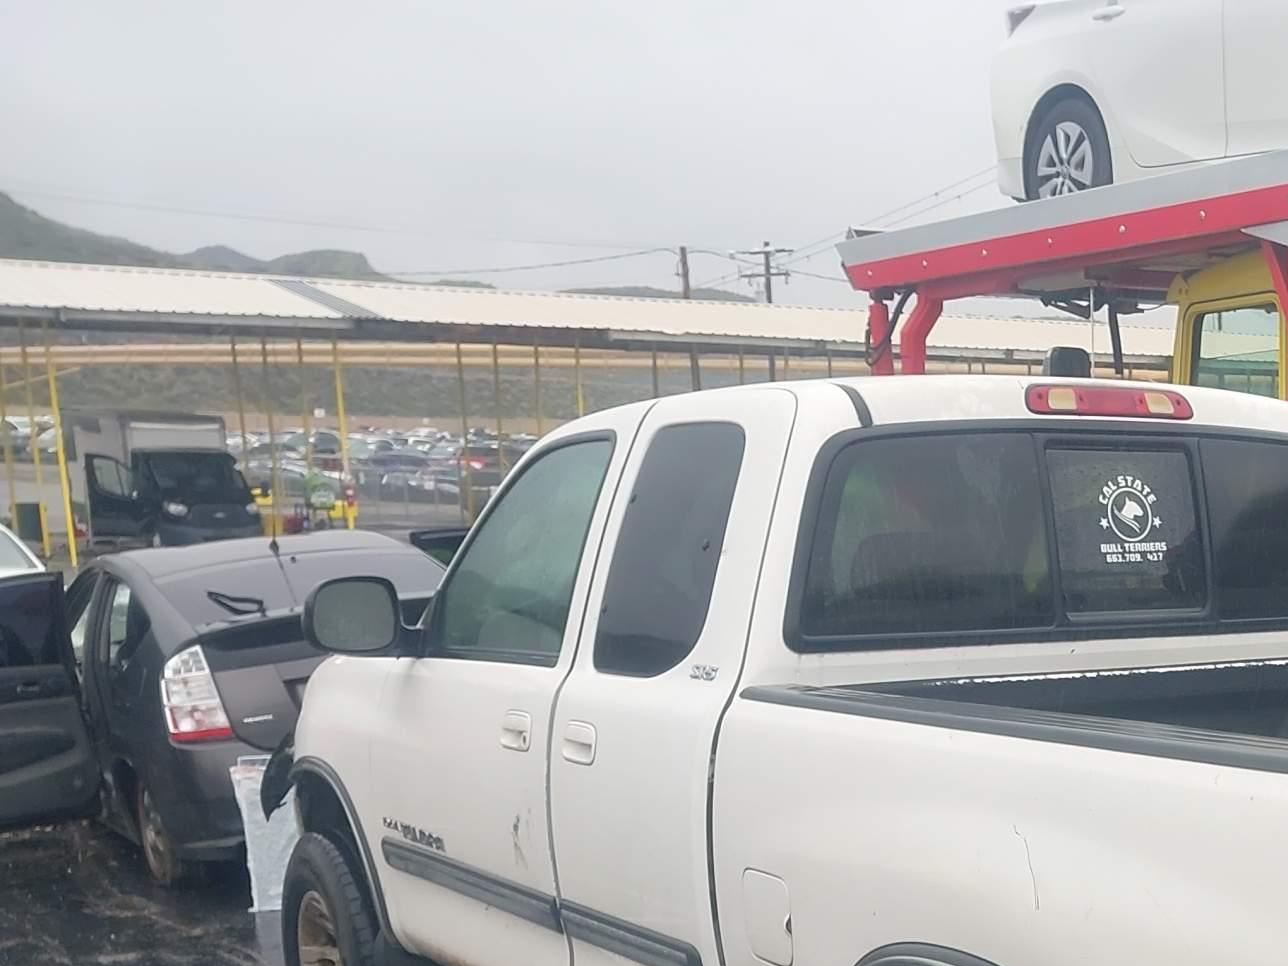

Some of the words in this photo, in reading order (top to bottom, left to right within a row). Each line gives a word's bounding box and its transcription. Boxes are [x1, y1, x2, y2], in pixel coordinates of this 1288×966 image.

[1098, 480, 1118, 505] CAL
[1117, 475, 1157, 505] STATE
[1100, 543, 1124, 553] BULL
[1124, 541, 1168, 552] TERRIERS
